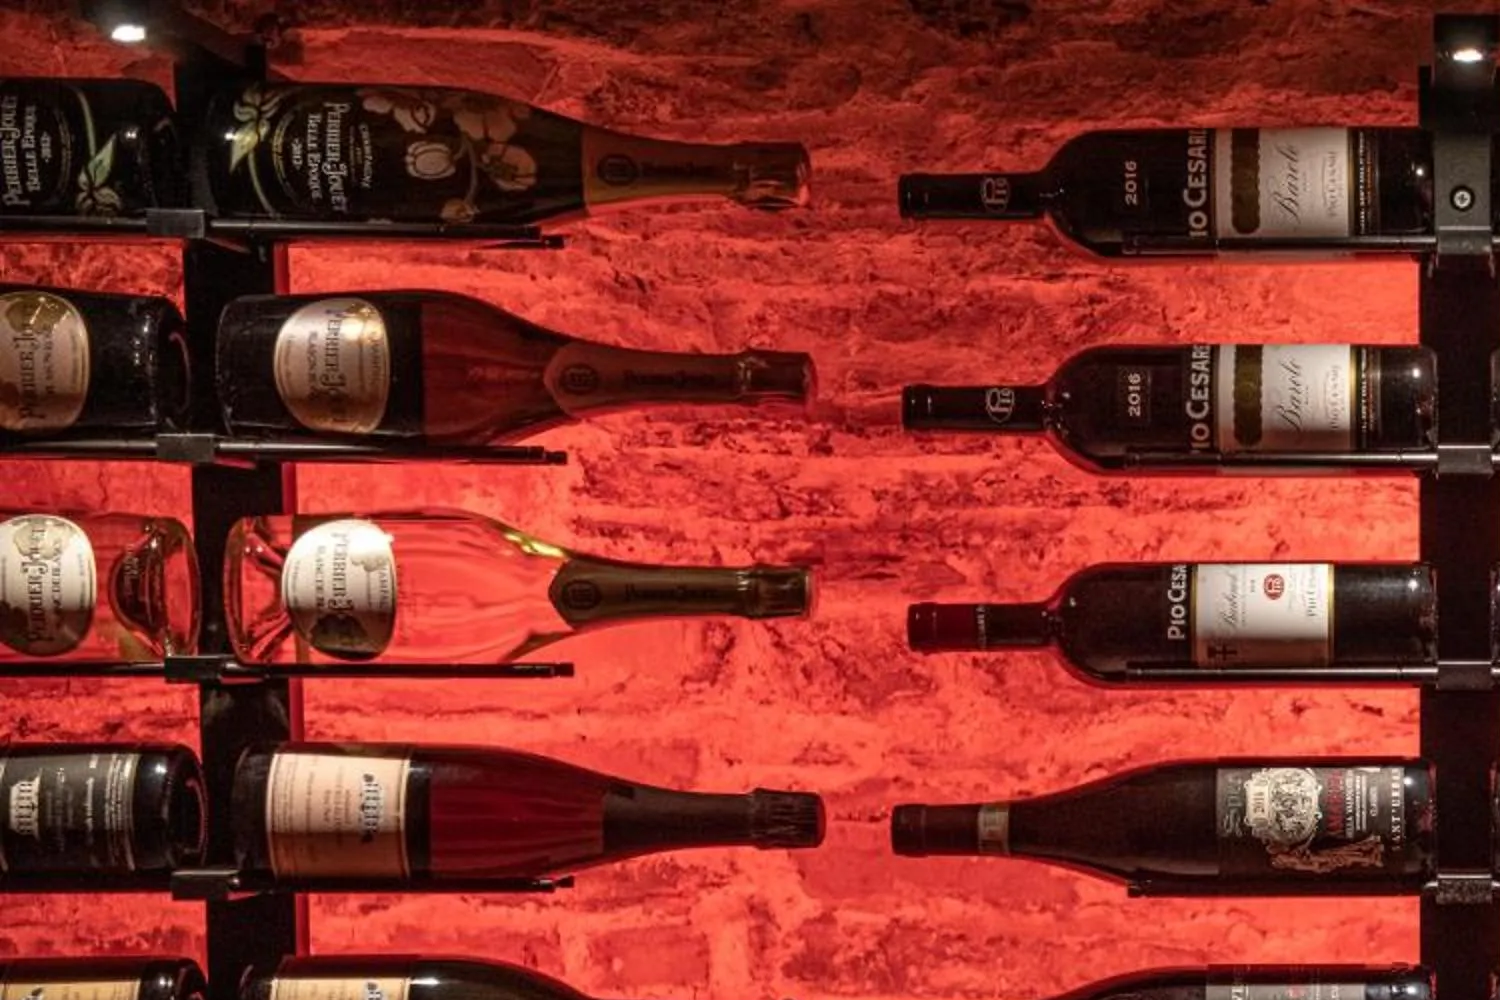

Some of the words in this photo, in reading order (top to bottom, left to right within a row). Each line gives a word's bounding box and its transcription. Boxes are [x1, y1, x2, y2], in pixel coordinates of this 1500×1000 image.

[307, 113, 320, 152] BELLE
[26, 149, 41, 192] BELLE
[1125, 160, 1138, 206] 2016
[1188, 215, 1208, 239] IO
[1126, 372, 1142, 418] 2016
[1274, 356, 1306, 432] Barolo
[1190, 424, 1210, 454] IO
[1168, 604, 1186, 640] PIO
